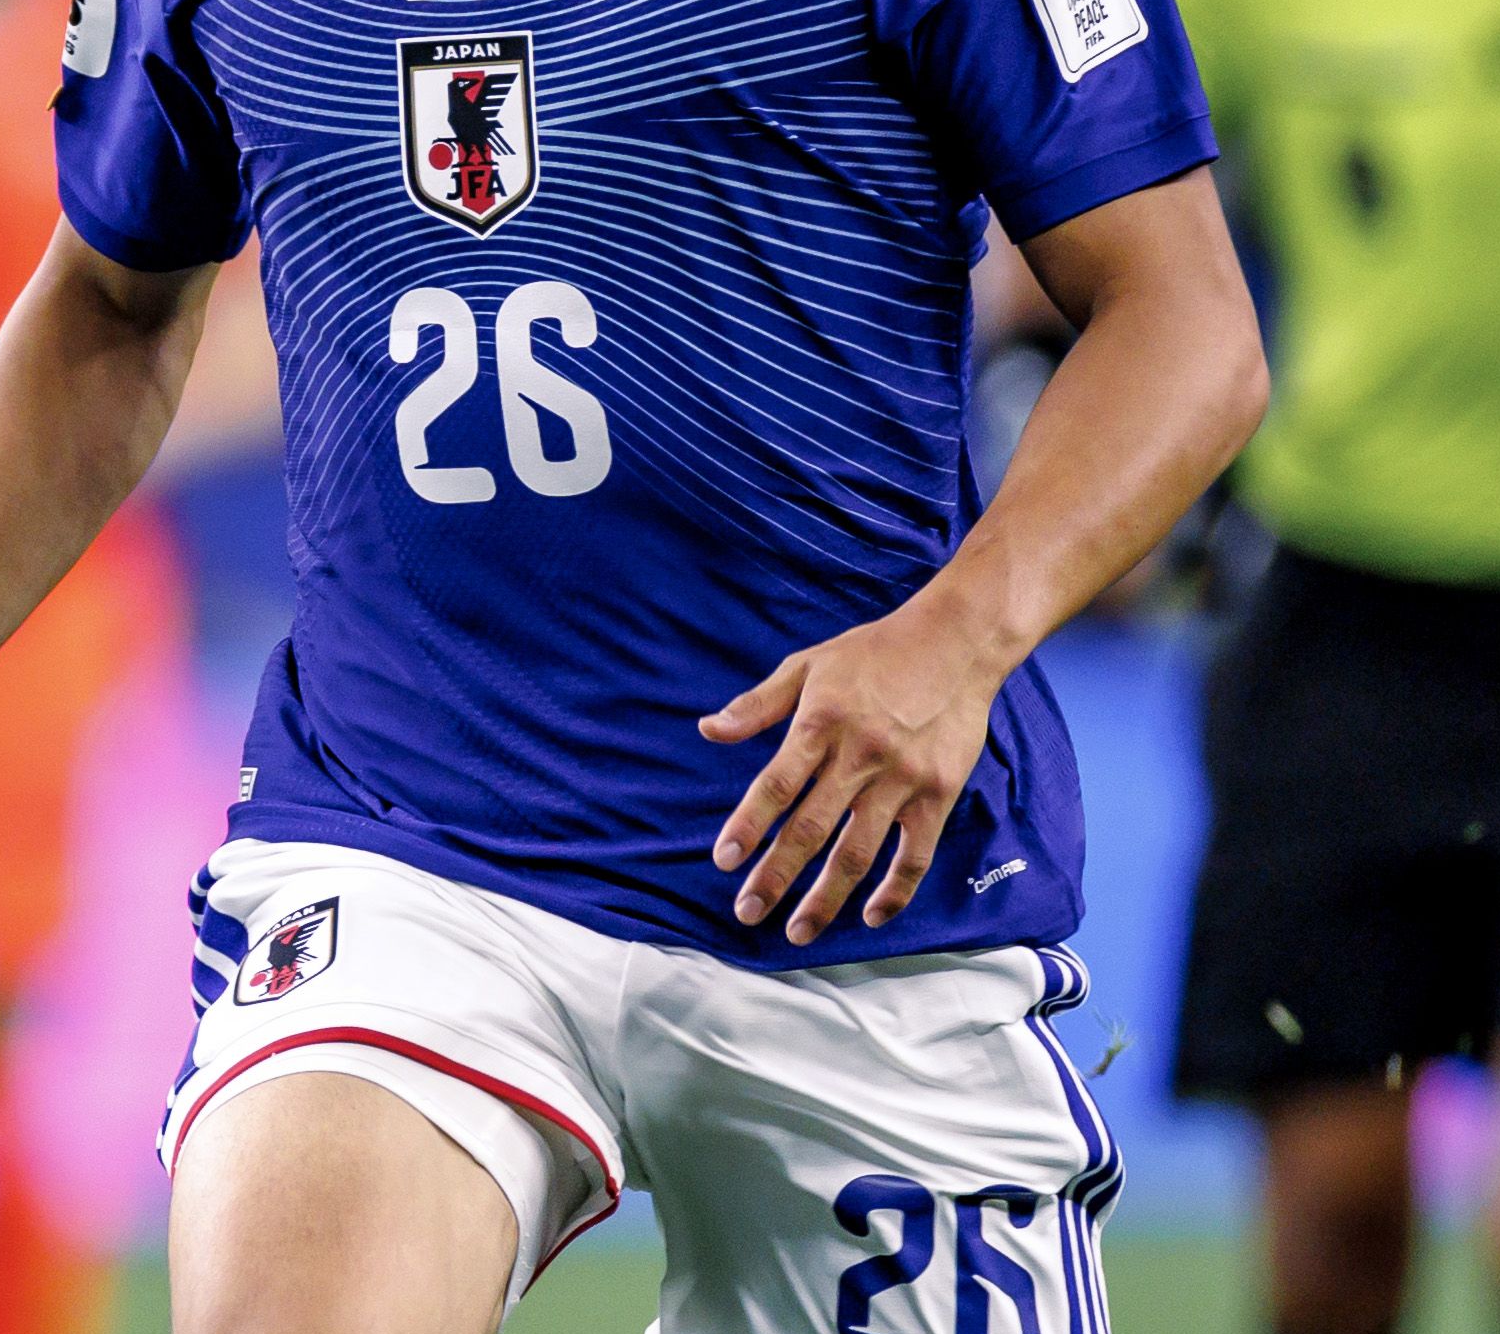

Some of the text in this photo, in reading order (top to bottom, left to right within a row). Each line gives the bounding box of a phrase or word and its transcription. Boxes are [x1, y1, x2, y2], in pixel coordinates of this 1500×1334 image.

[433, 42, 500, 60] JAPAN
[1085, 30, 1105, 50] FIFA
[446, 169, 507, 200] JFA
[388, 280, 612, 504] 26
